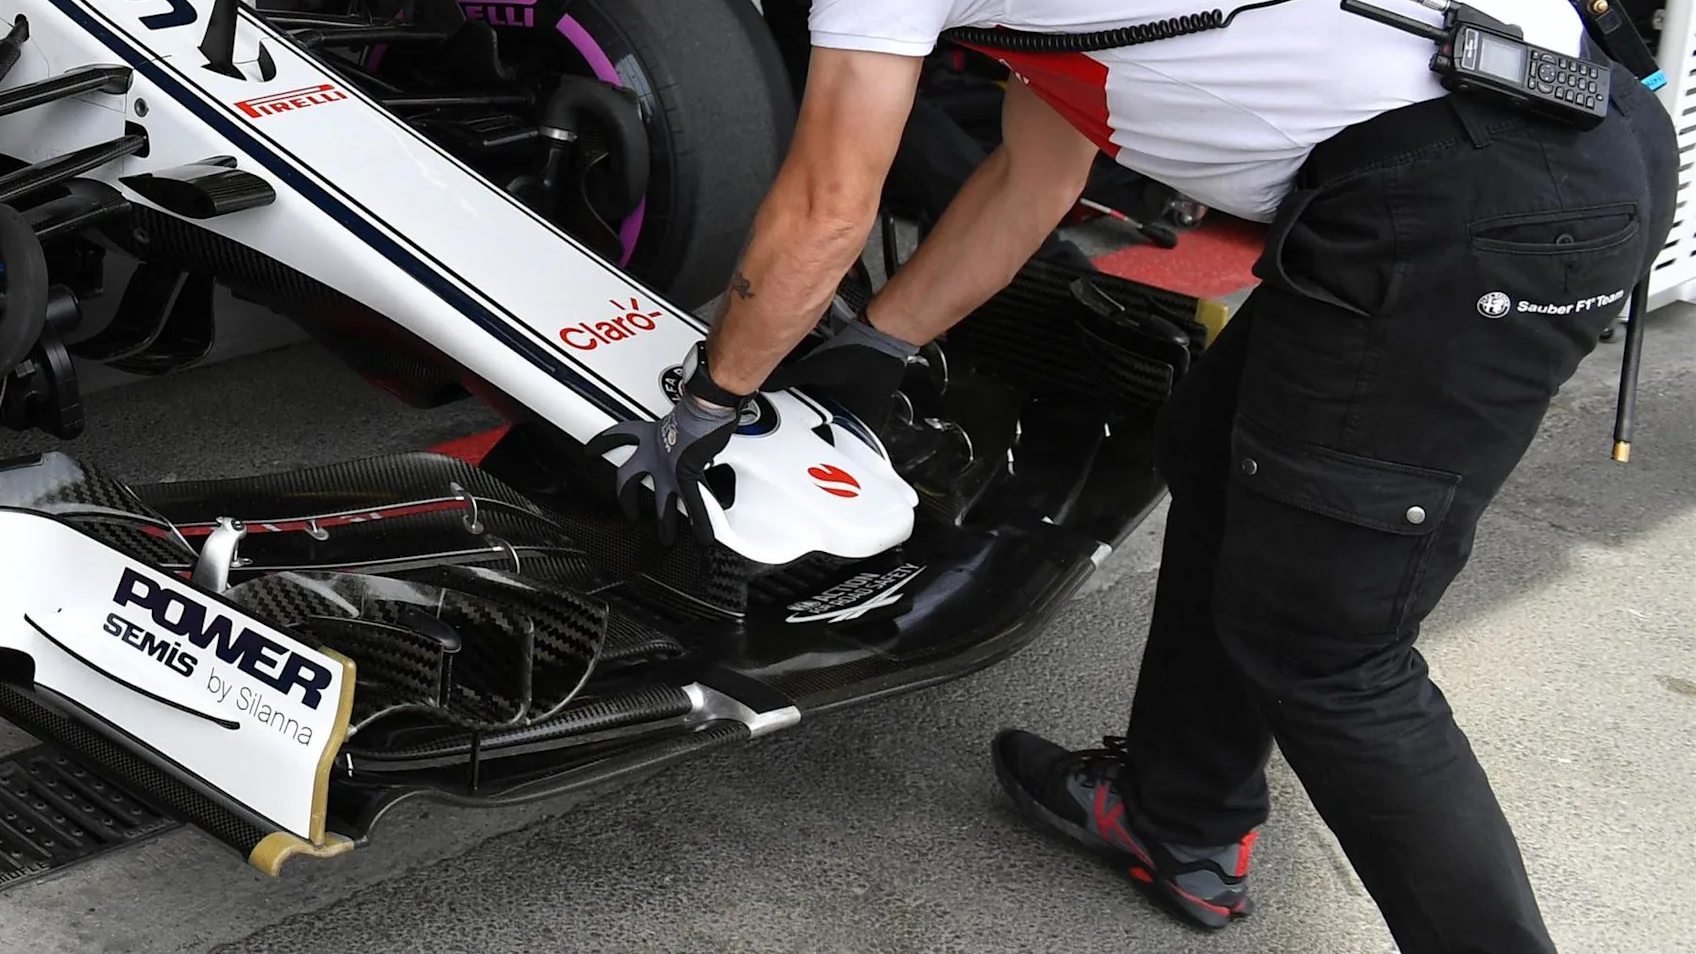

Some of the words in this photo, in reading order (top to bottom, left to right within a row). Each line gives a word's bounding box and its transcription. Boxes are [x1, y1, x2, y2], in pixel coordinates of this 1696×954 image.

[232, 83, 349, 119] PIRELLI
[1516, 300, 1574, 315] Sauber
[1596, 289, 1624, 308] Team
[559, 310, 658, 351] Claro
[811, 572, 881, 602] ACTION
[864, 562, 920, 590] SAFETY
[112, 566, 332, 711] POWER
[206, 667, 233, 703] by
[236, 686, 314, 747] Silanna
